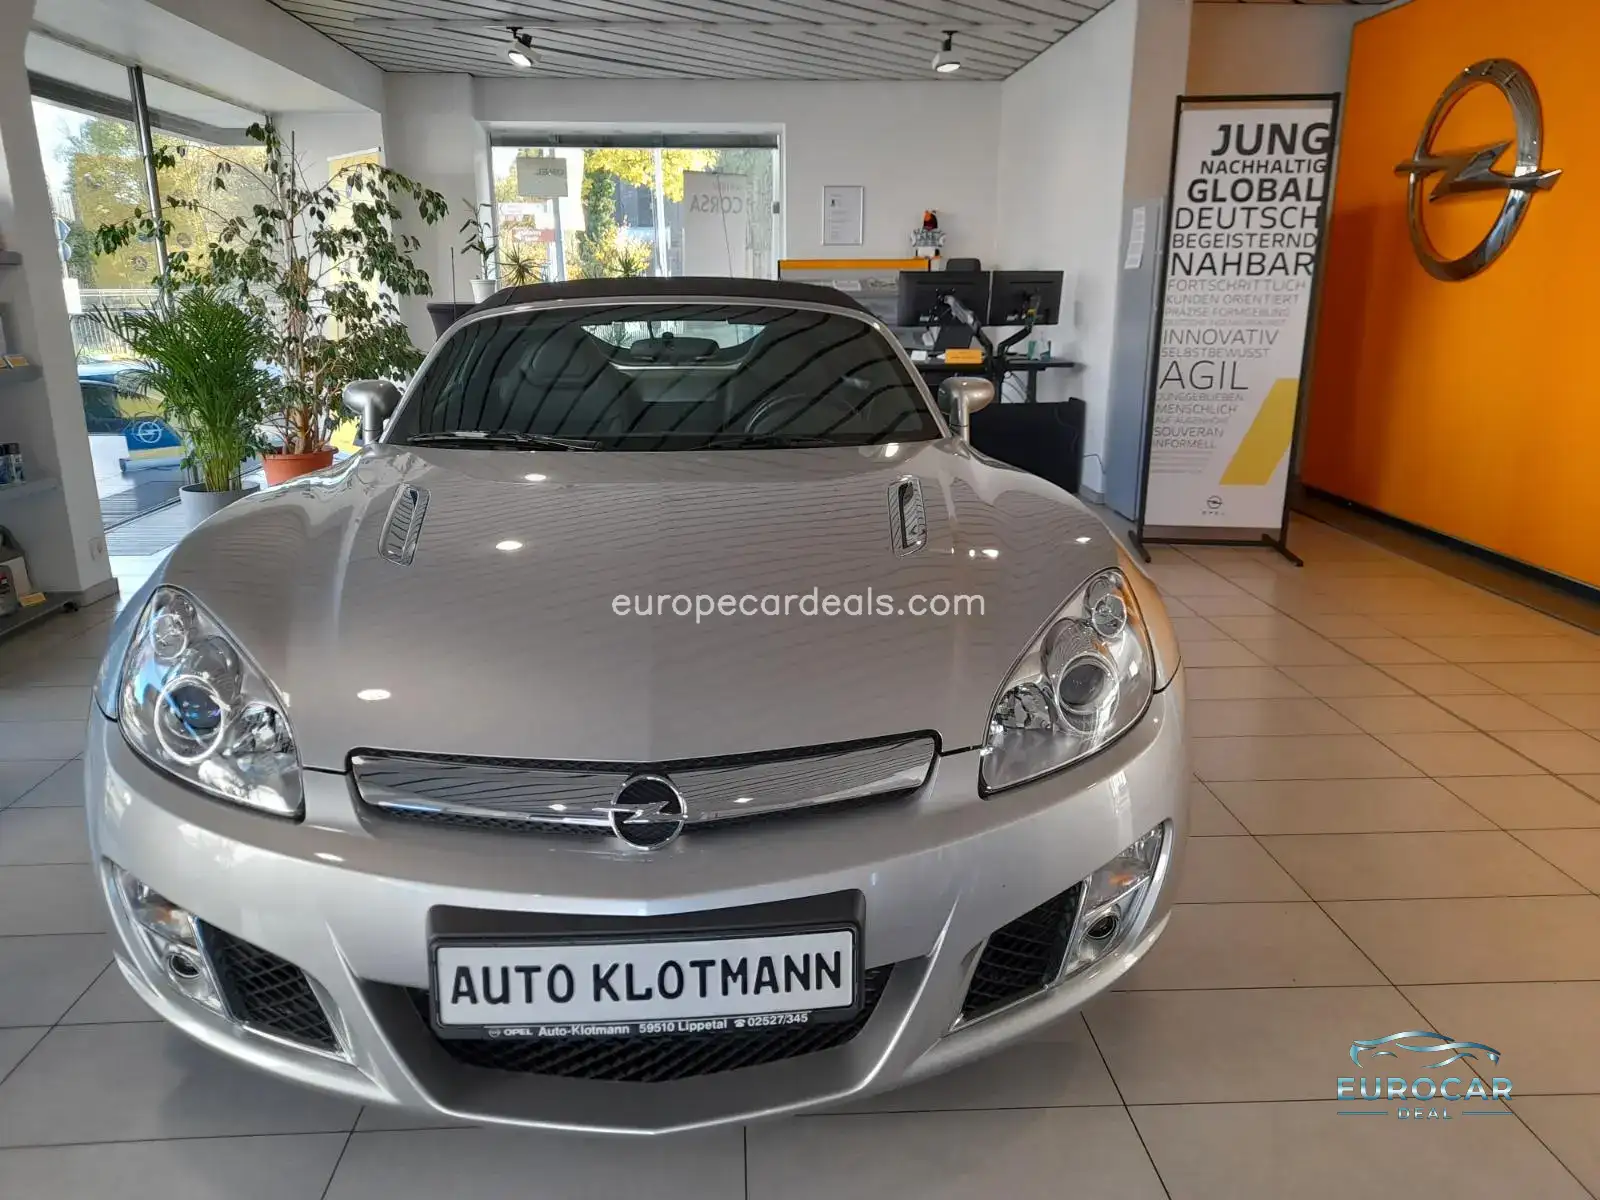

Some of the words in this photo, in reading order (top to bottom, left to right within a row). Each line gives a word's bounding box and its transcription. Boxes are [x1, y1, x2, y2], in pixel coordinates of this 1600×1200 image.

[1210, 123, 1331, 156] JUNG
[1200, 159, 1328, 174] NACHHALTIG
[1187, 177, 1325, 203] GLOBAL
[1175, 206, 1320, 230] DEUTSCH
[1172, 232, 1317, 249] BEGEISTERND
[1170, 252, 1315, 276] NAHBAR
[1167, 279, 1306, 292] FORTSCHRITTLICH
[1163, 329, 1280, 345] INNOVATIV
[1160, 347, 1270, 358] SELBSTBEWUSST
[1159, 360, 1249, 390] AGIL
[1155, 403, 1238, 415] MENSCHLICH
[1152, 439, 1217, 449] INFORMELL
[451, 963, 574, 1005] AUTO
[592, 950, 841, 1002] KLOTMANN
[538, 1024, 630, 1037] Auto-Klotmann
[638, 1023, 675, 1034] 59510
[677, 1018, 728, 1034] Lippetal
[747, 1012, 809, 1027] 02527/345
